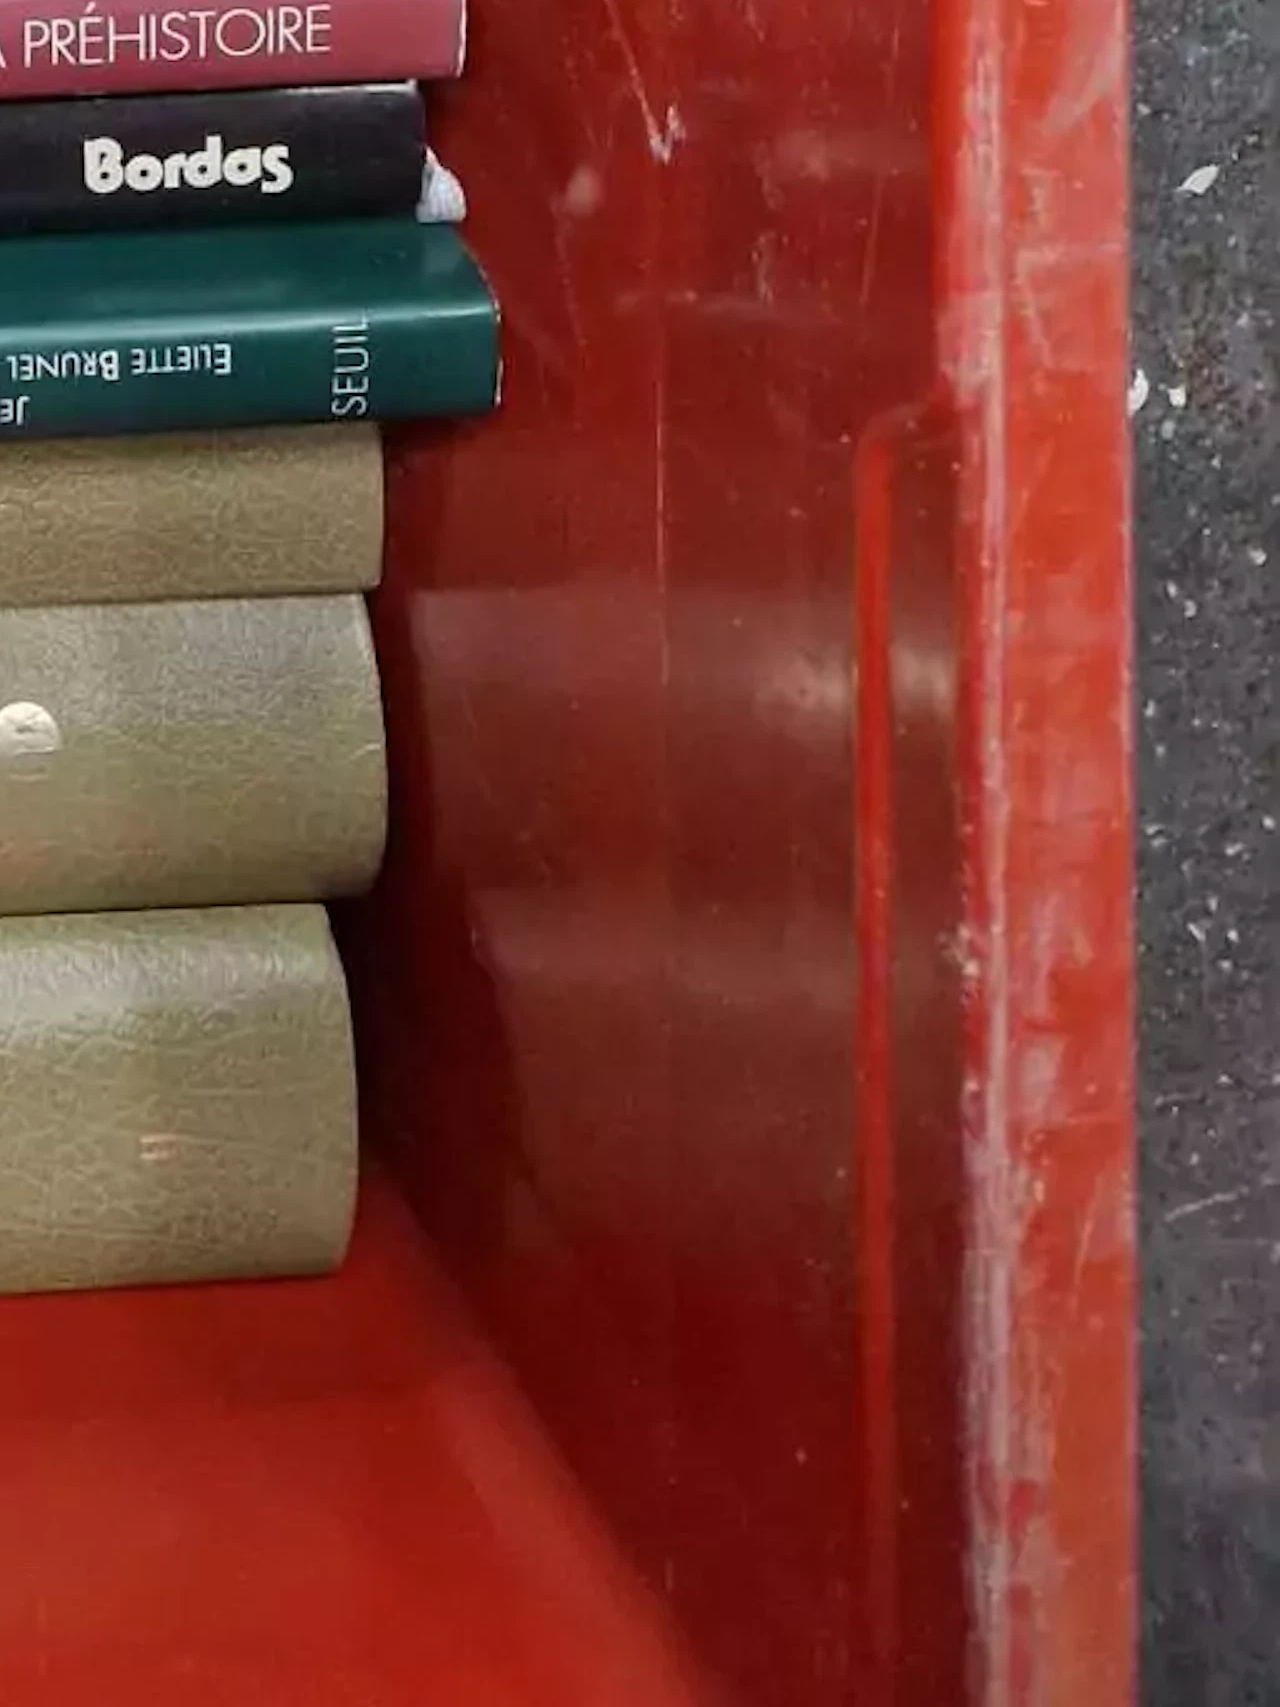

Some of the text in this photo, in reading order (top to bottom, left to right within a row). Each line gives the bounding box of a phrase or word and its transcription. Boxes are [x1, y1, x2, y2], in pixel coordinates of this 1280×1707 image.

[22, 0, 331, 67] PRÉHISTOIRE
[83, 136, 294, 196] Bordas
[6, 347, 120, 382] BRUNEL
[130, 342, 233, 375] ELIETTE
[332, 319, 368, 414] SEUIL
